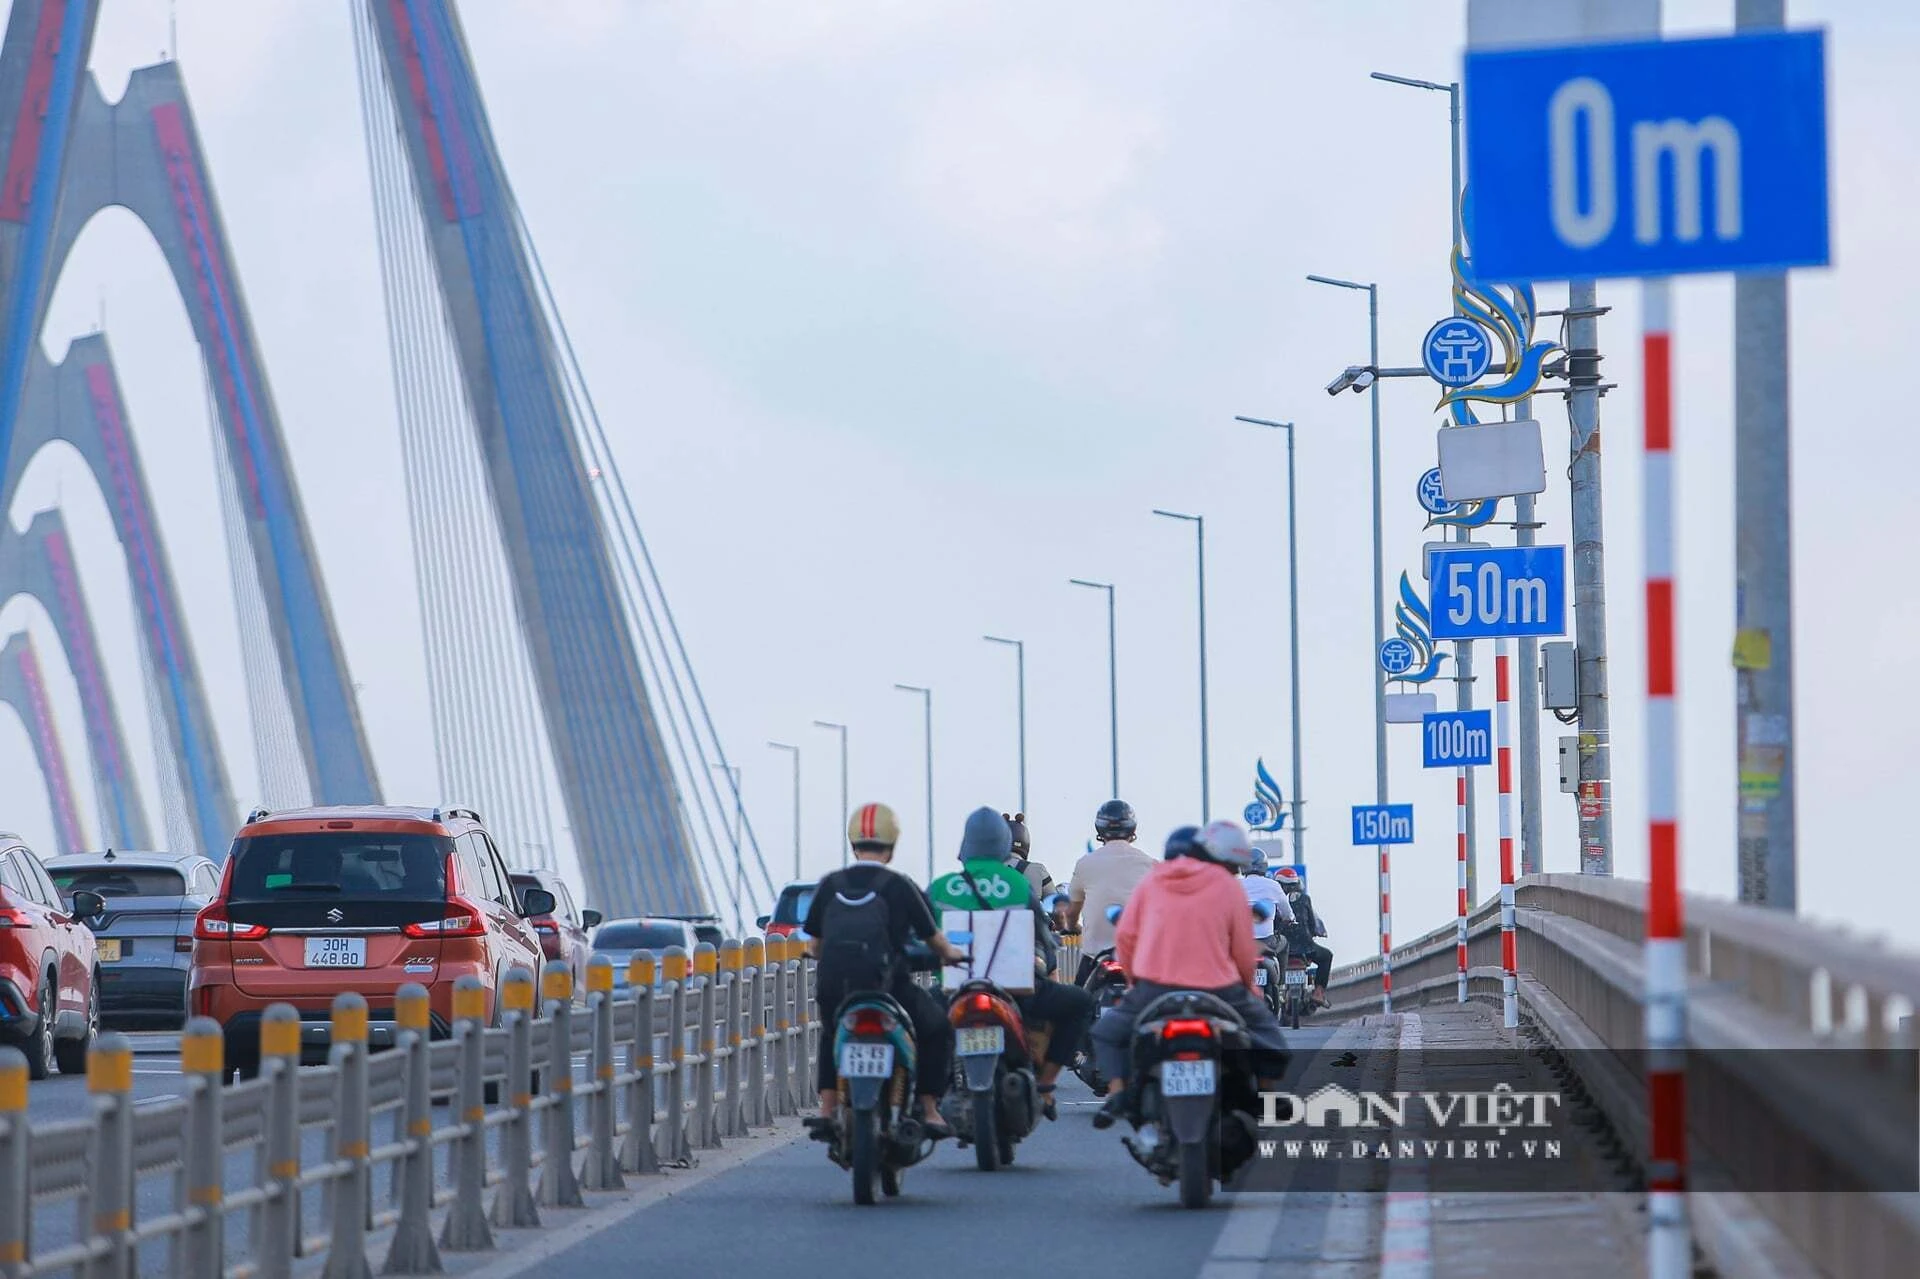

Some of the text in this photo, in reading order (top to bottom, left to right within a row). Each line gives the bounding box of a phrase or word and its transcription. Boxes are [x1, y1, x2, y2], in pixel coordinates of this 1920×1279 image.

[1549, 77, 1742, 248] 0m
[1448, 561, 1547, 626] 50m
[1428, 719, 1487, 760] 100m
[1355, 810, 1410, 840] 150m
[312, 952, 359, 965] 448.80
[323, 939, 348, 951] 30H
